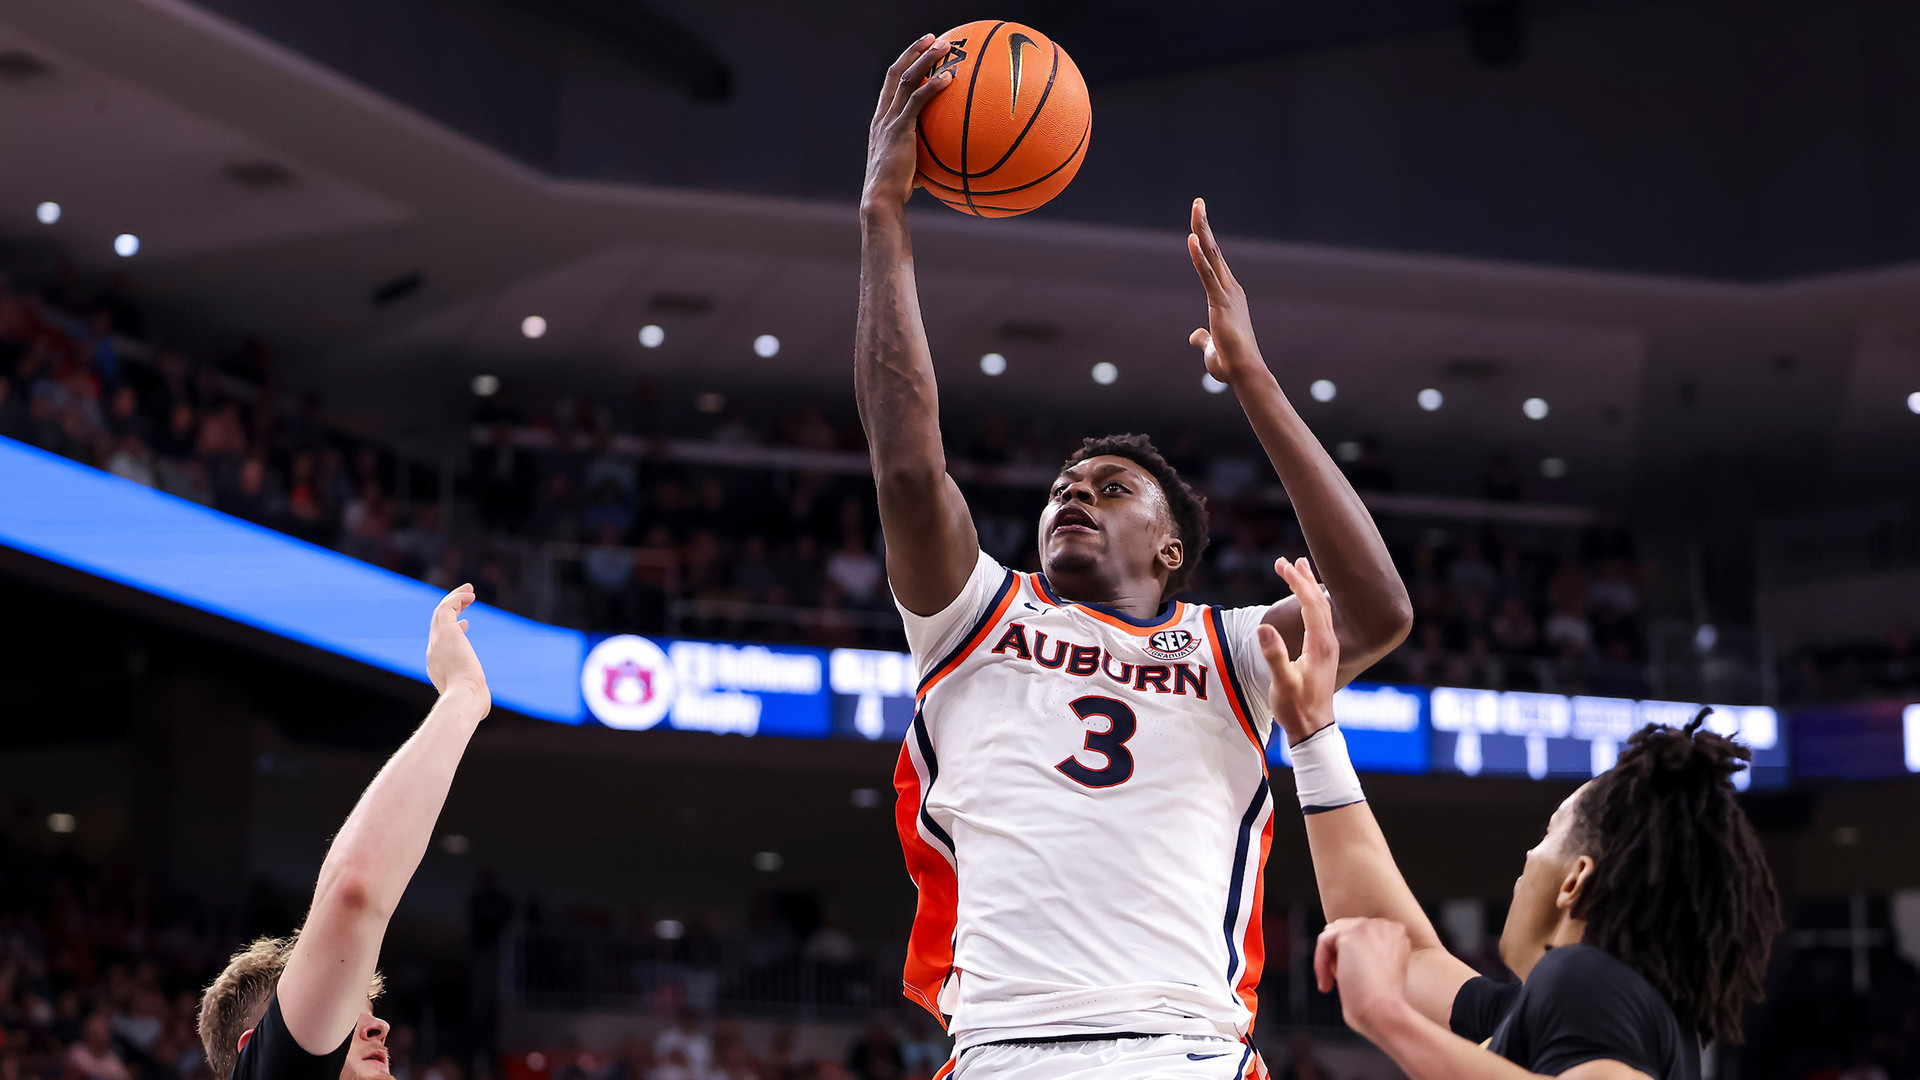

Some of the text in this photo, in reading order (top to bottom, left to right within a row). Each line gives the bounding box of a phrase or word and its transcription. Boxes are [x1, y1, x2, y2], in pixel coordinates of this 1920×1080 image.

[991, 622, 1208, 700] AUBURN
[1151, 644, 1196, 659] GRADUATE
[1152, 631, 1190, 652] SEC
[1055, 695, 1137, 788] 3
